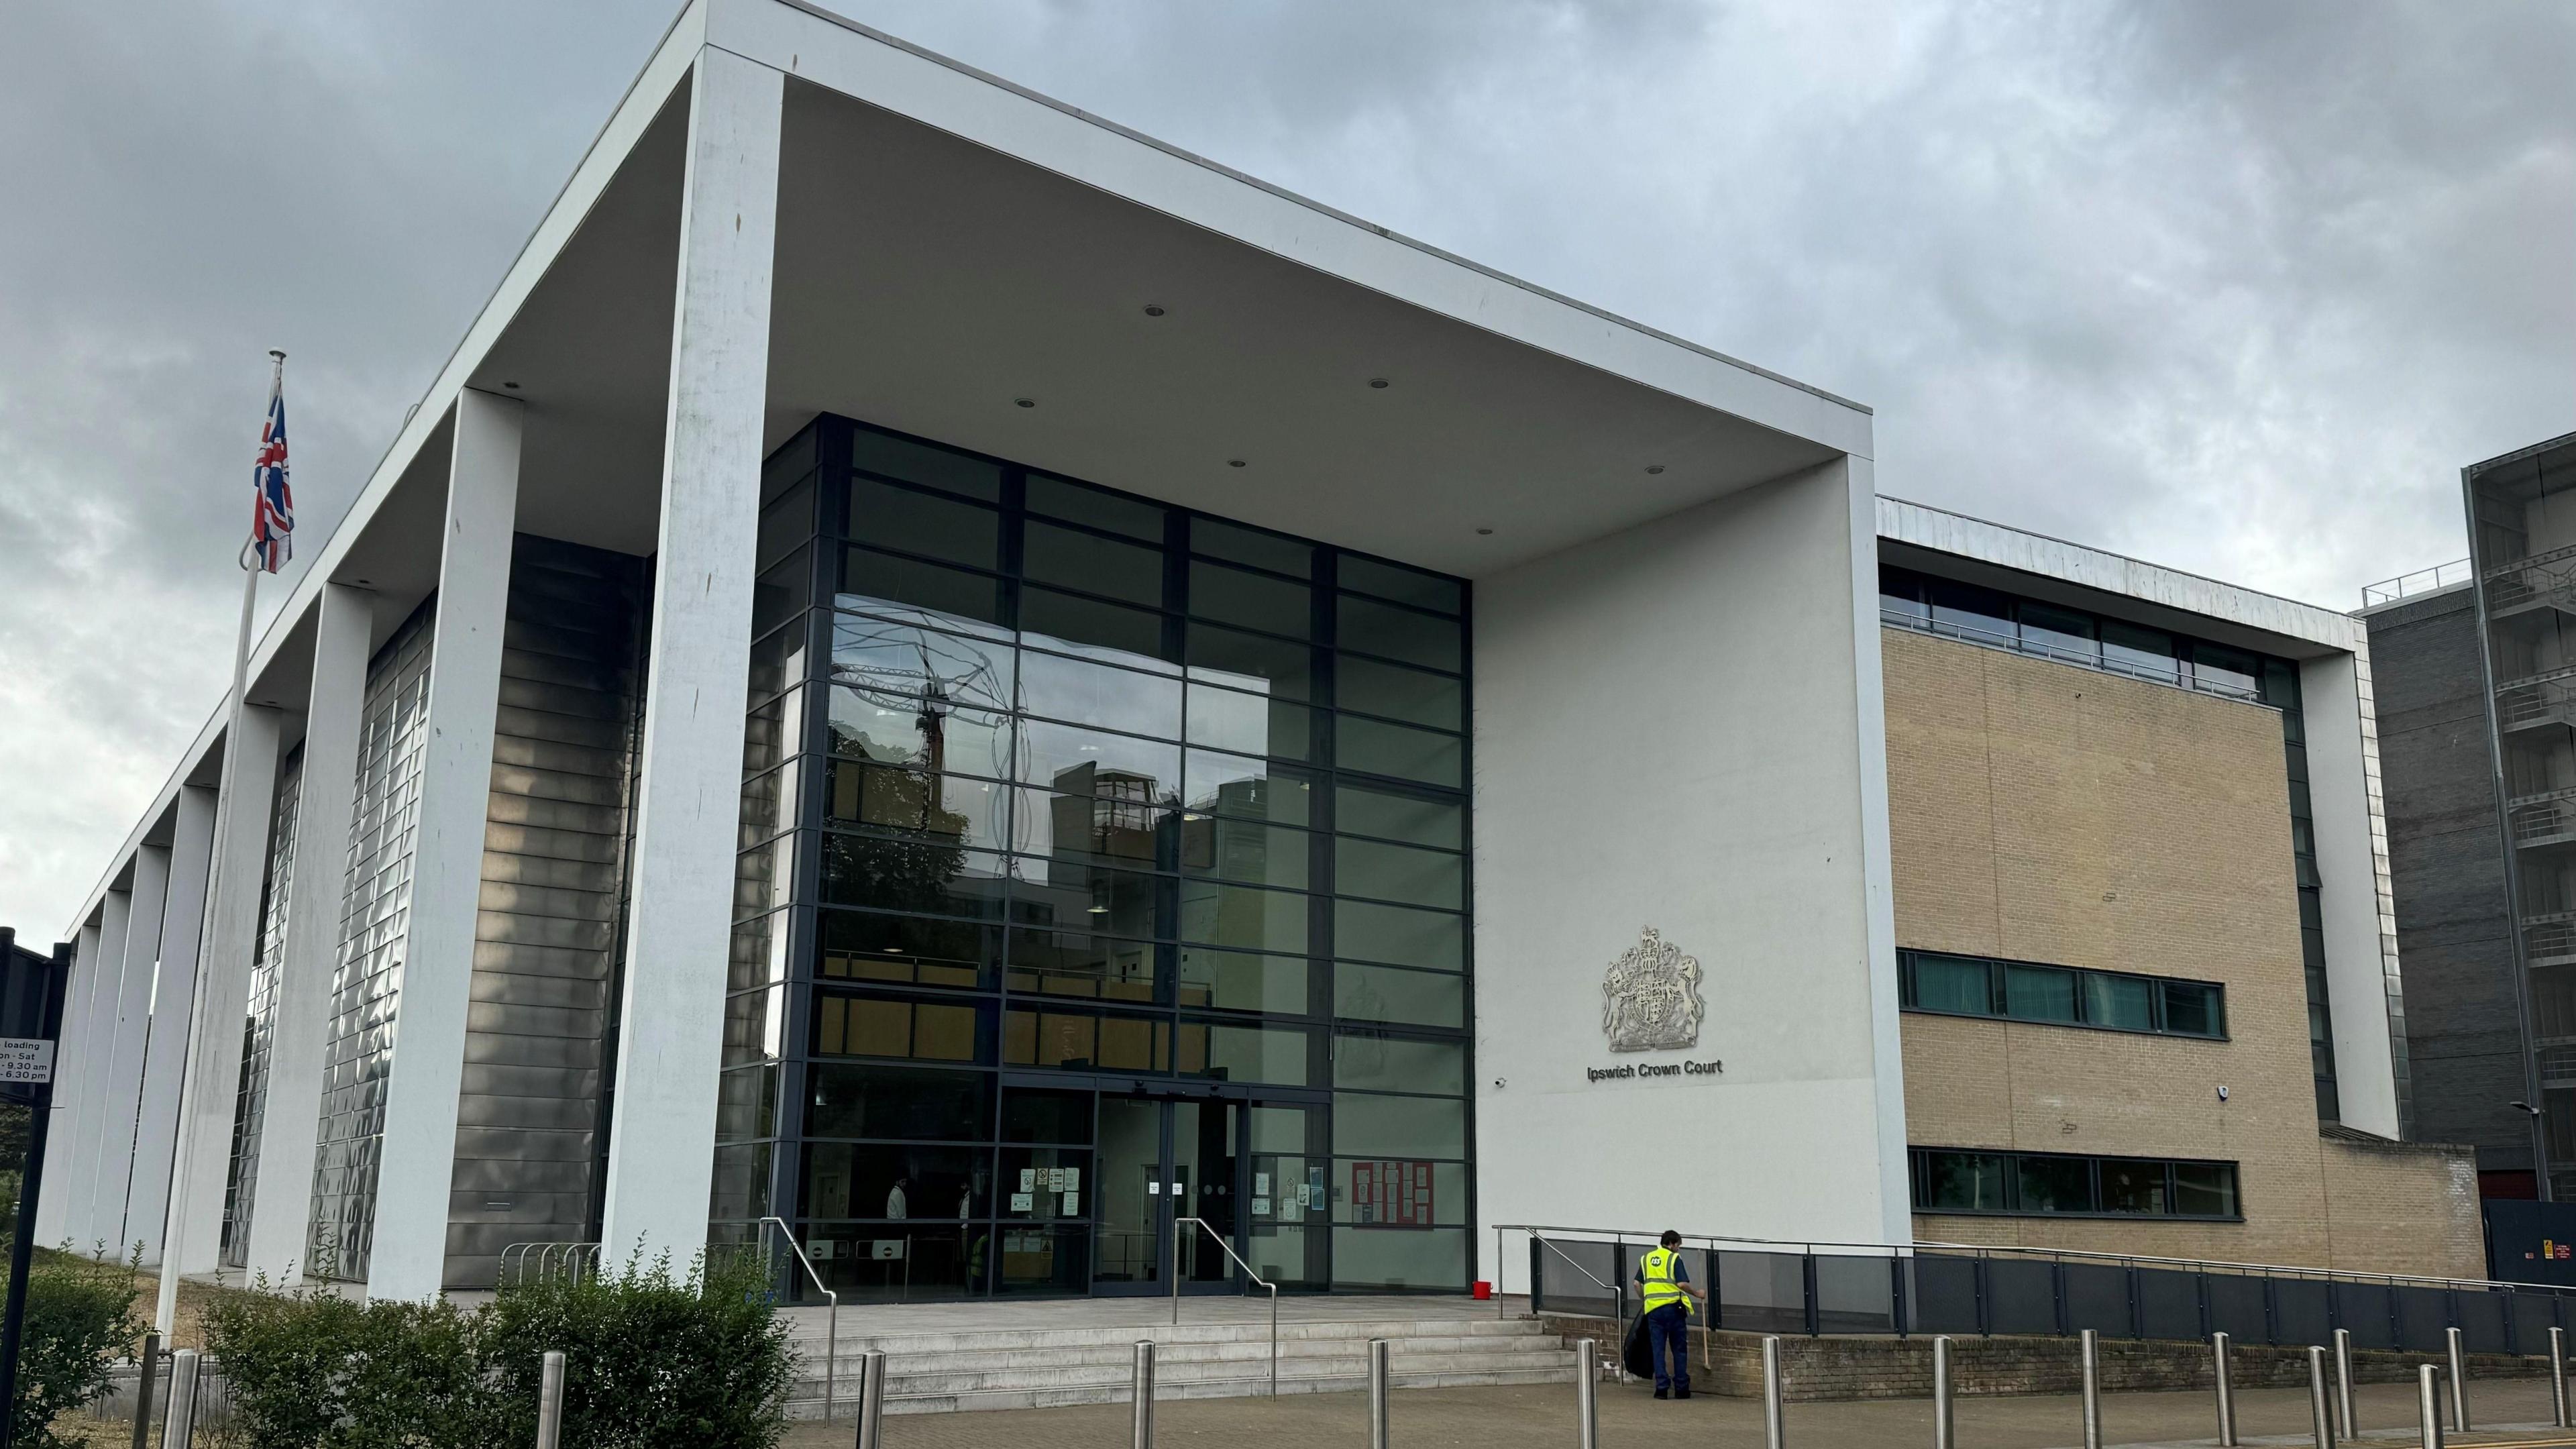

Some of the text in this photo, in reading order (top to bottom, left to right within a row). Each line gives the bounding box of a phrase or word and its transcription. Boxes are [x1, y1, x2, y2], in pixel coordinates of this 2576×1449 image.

[5, 1040, 40, 1050] loading
[1587, 1059, 1723, 1083] Ipswich Crown Court
